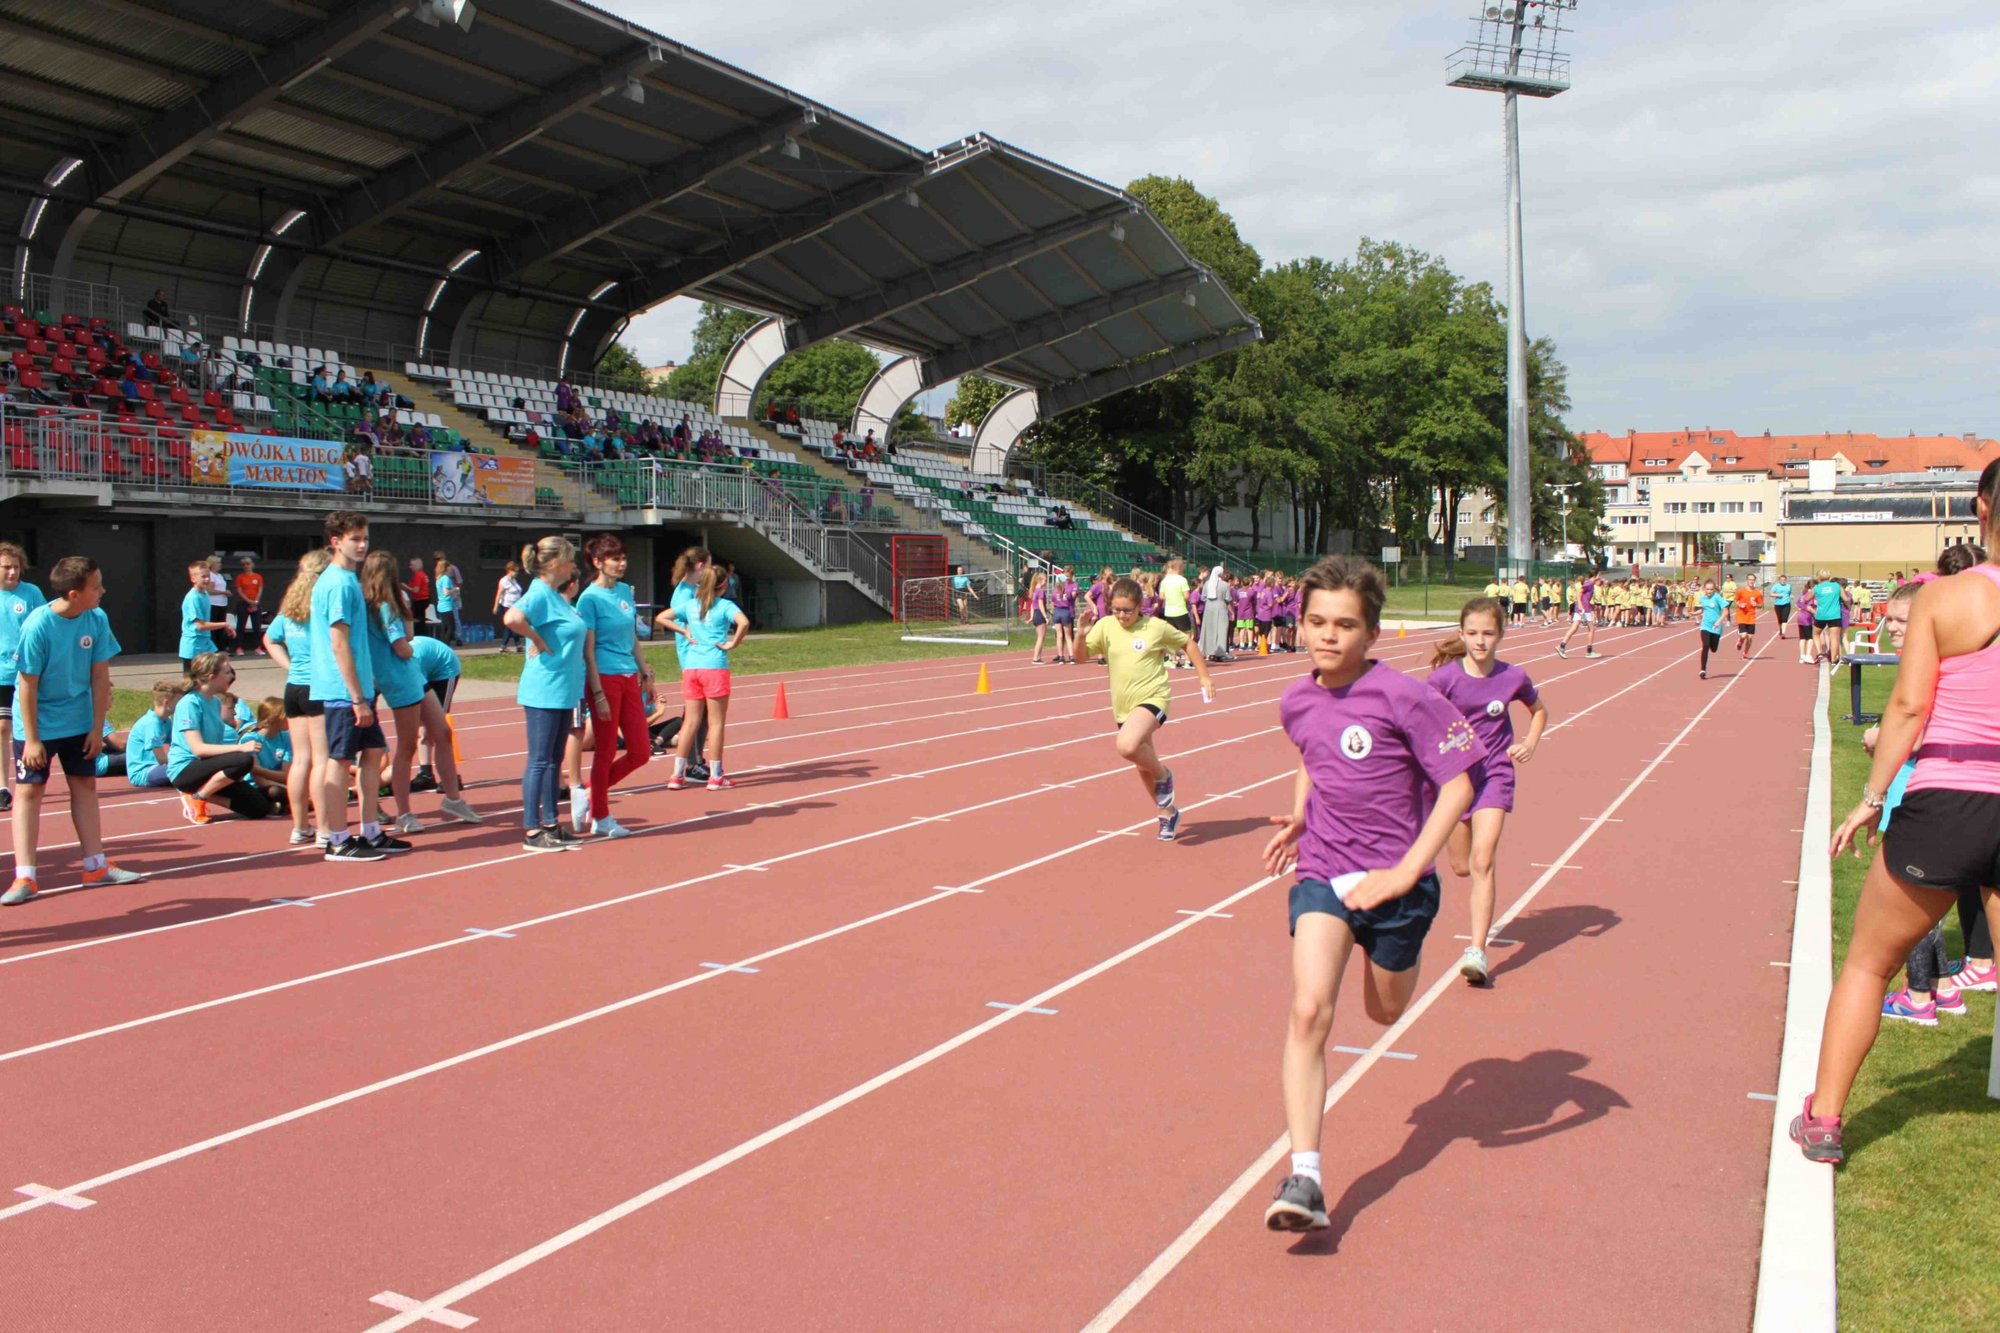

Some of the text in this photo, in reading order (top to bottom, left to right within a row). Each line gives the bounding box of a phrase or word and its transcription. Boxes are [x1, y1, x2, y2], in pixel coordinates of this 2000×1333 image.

[223, 439, 295, 461] DWÓJKA
[244, 464, 328, 483] MARATON
[16, 759, 27, 780] 3
